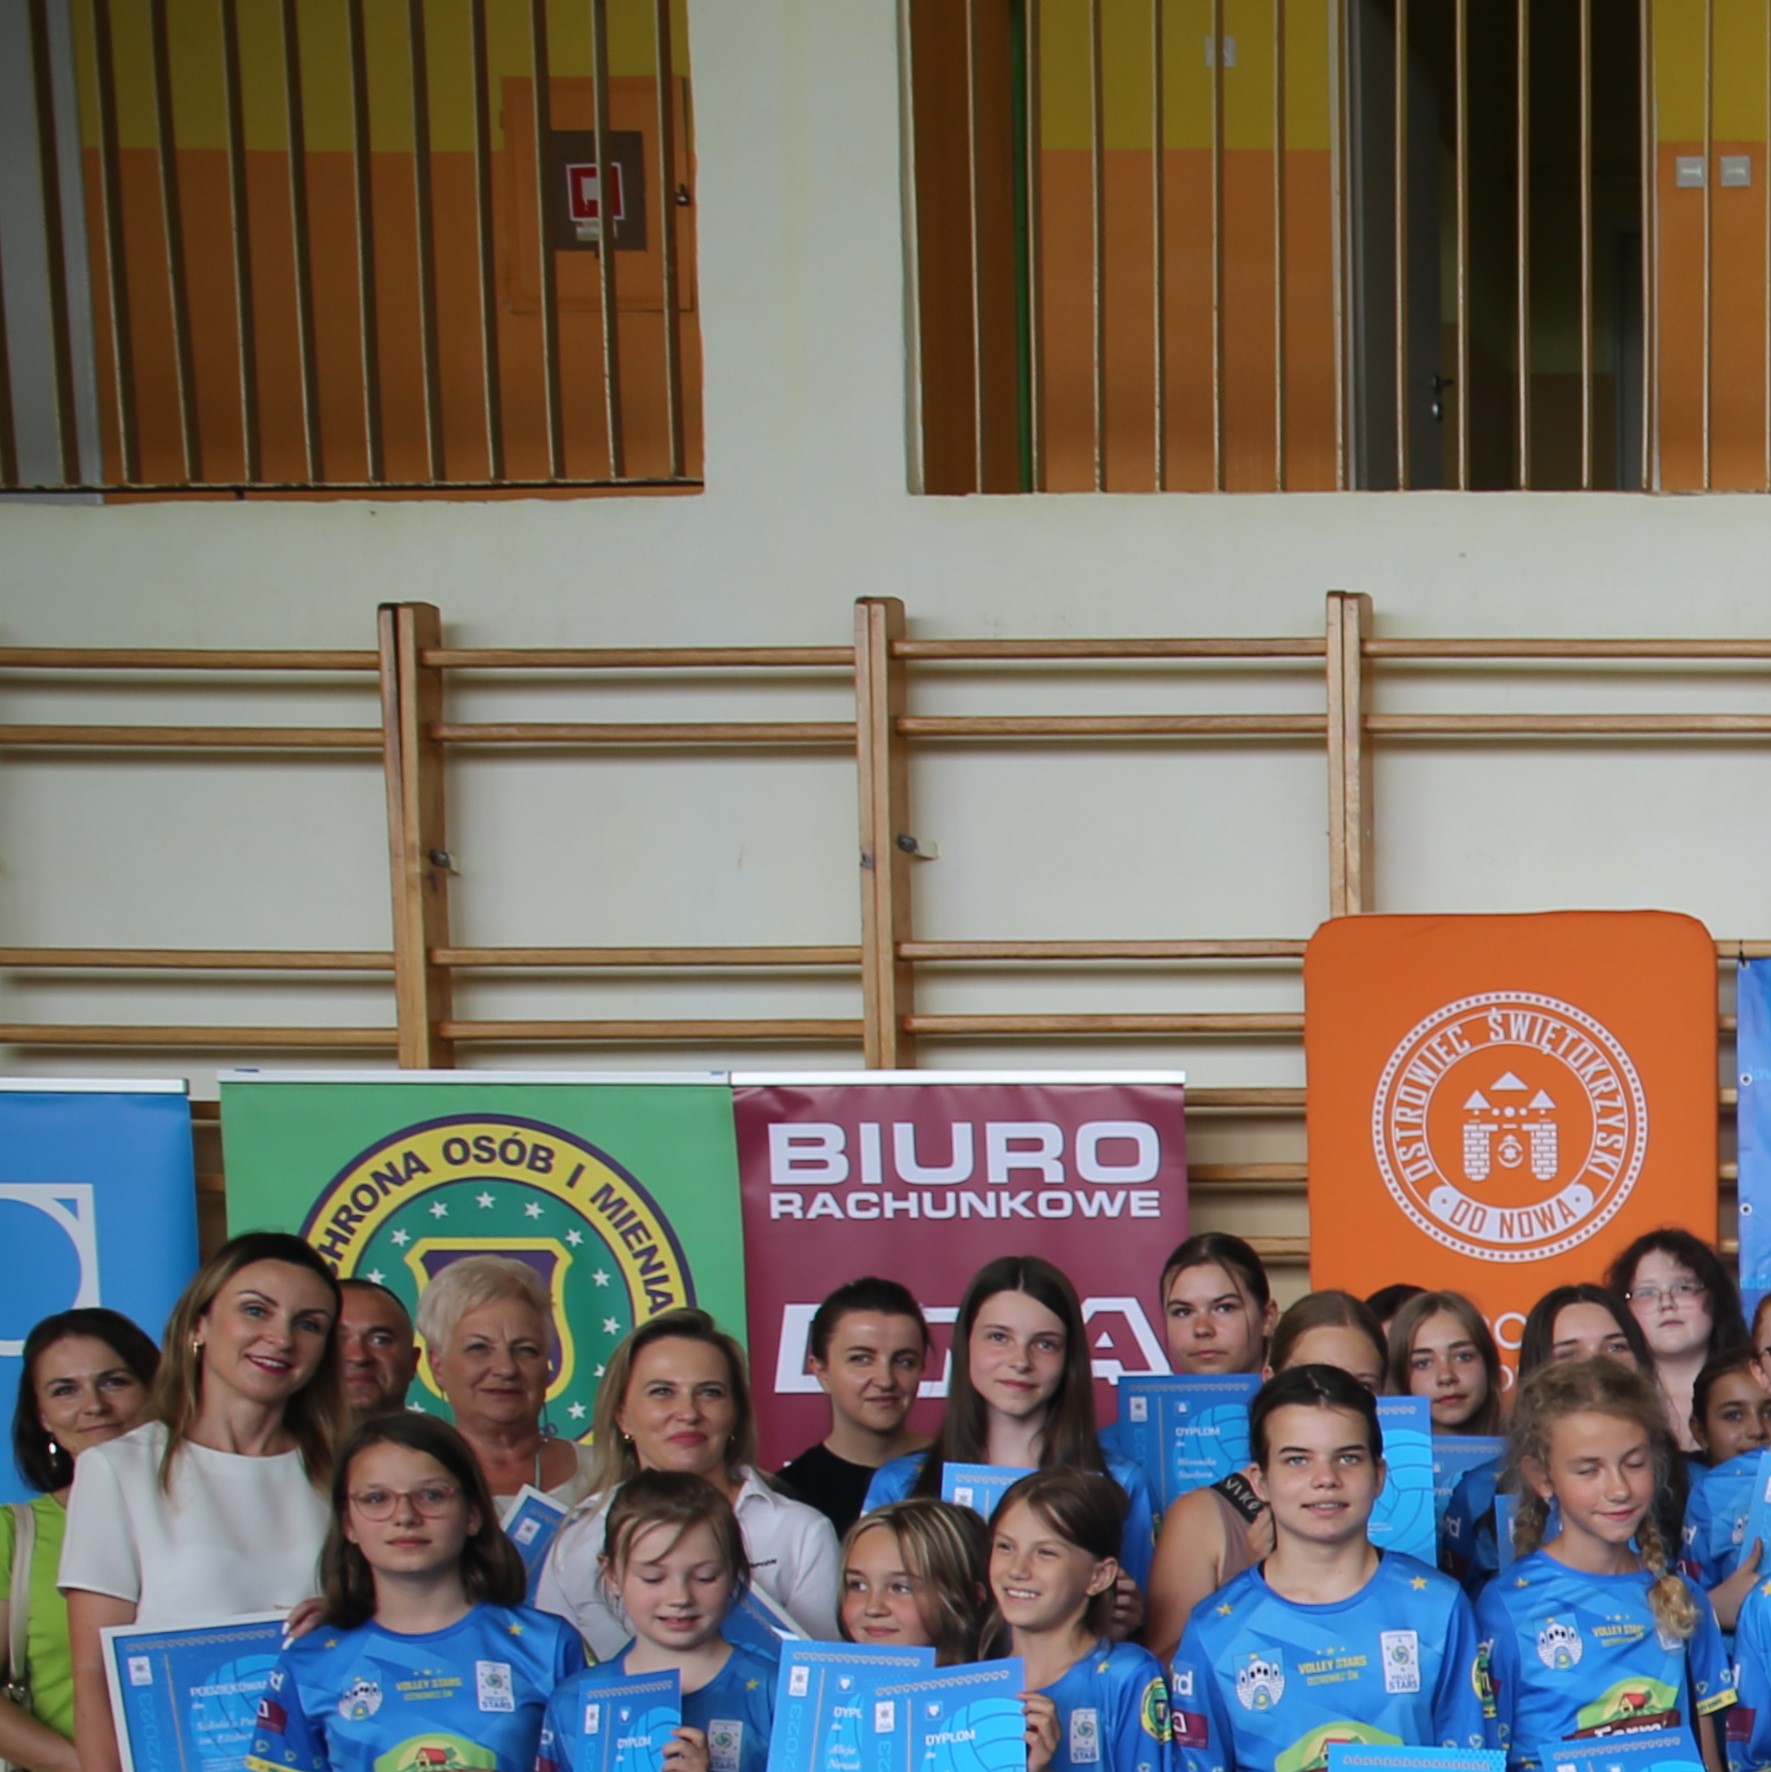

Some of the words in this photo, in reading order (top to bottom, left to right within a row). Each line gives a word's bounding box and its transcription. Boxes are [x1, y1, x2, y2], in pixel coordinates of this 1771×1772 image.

[1394, 1023, 1473, 1184] OSTROWIEC
[1486, 1006, 1628, 1181] ŚWIĘTOKRZYSKI
[767, 1120, 1162, 1186] BIURO
[318, 1150, 431, 1272] HRONA
[442, 1132, 556, 1175] OSÓB
[565, 1162, 587, 1190] I
[590, 1182, 675, 1314] MIENIA
[769, 1190, 1162, 1221] RACHUNKOWE
[1449, 1198, 1487, 1234] OD
[1499, 1198, 1577, 1239] NOWA
[1388, 1680, 1419, 1691] STARS
[925, 1730, 976, 1746] DYPLOM
